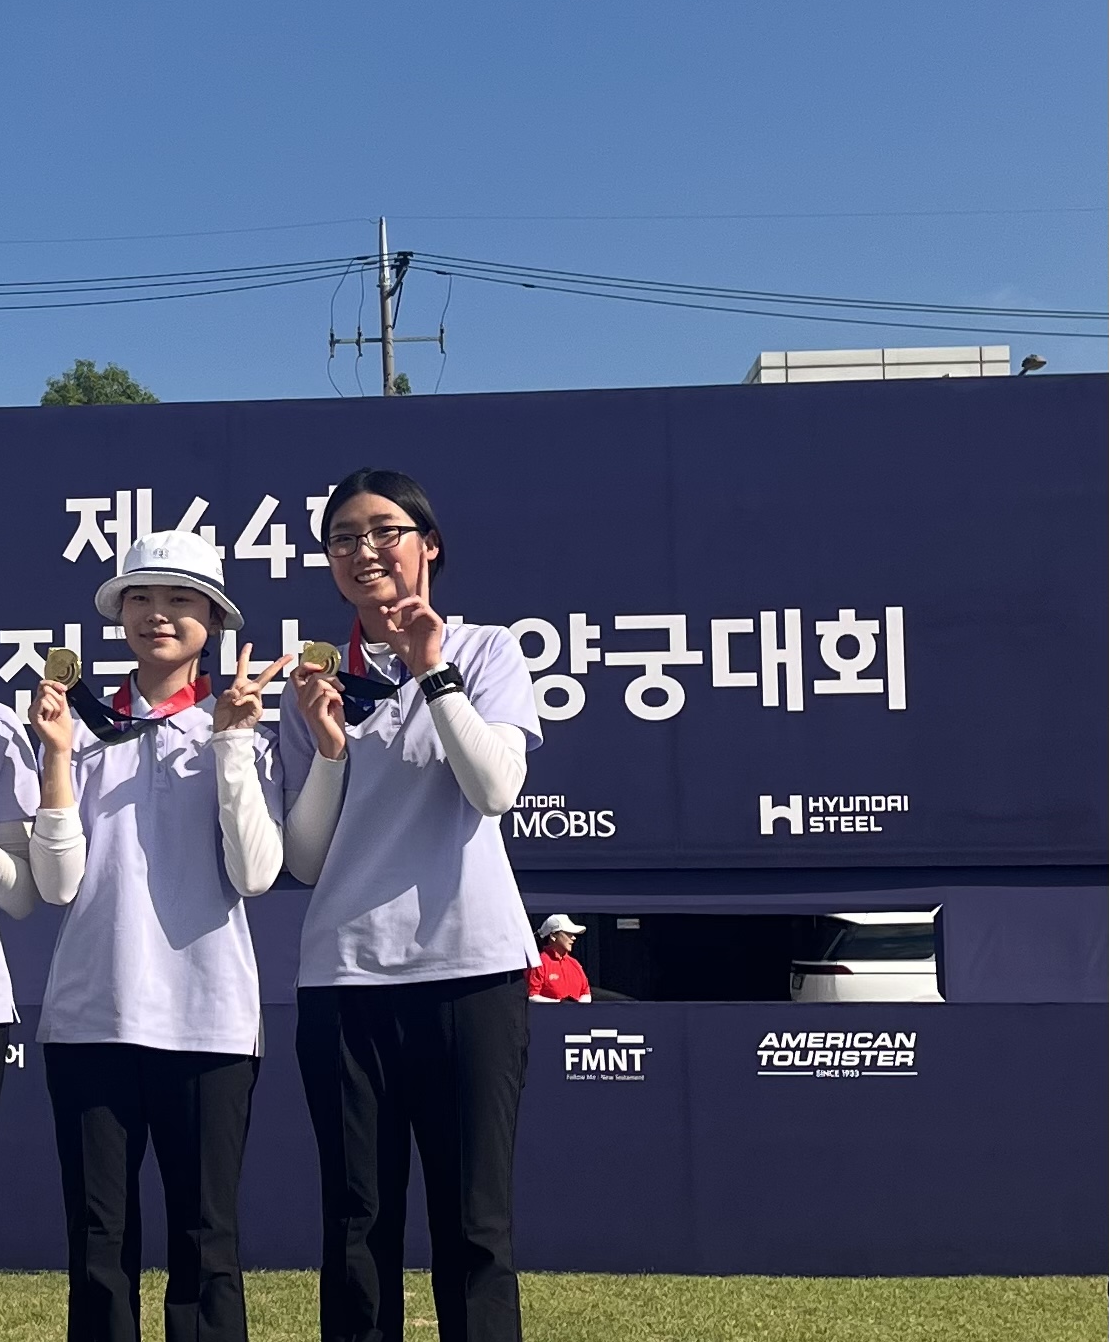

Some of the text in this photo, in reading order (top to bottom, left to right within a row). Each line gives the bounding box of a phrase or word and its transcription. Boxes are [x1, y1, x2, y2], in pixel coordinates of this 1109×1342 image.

[509, 606, 907, 721] 양궁대회
[513, 795, 565, 808] UNDAI
[809, 795, 909, 813] HYUNDAI
[512, 810, 616, 839] MOBIS
[809, 815, 883, 833] STEEL
[759, 1032, 917, 1048] AMERICAN
[565, 1048, 646, 1071] FMNT
[756, 1050, 915, 1066] TOURISTER
